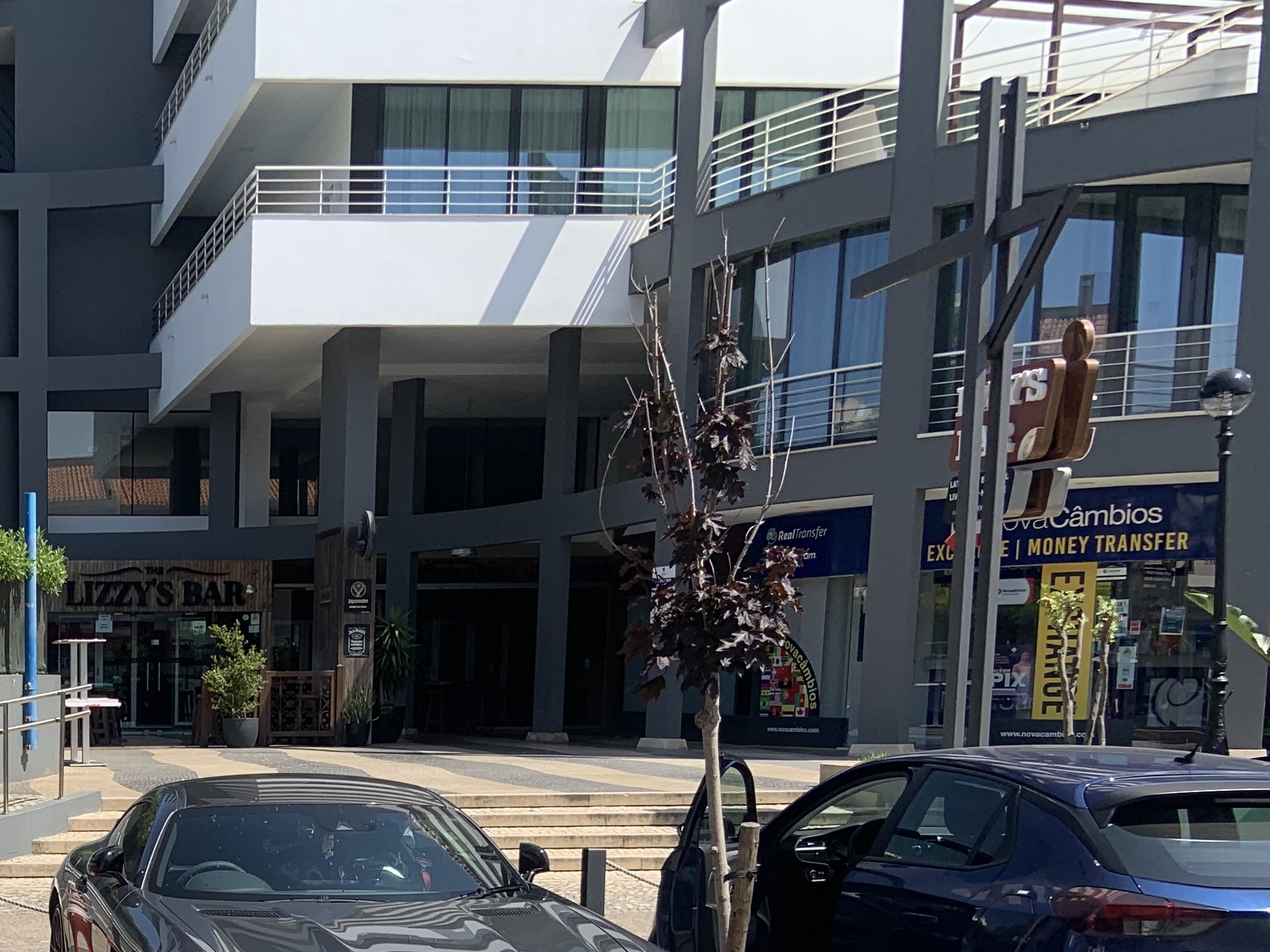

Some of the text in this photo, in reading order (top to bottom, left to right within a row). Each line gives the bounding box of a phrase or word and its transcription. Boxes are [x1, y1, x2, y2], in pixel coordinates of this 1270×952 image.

[1027, 536, 1089, 556] MONEY
[1094, 531, 1188, 552] TRANSFER
[66, 578, 247, 606] LIZZY'S BAR
